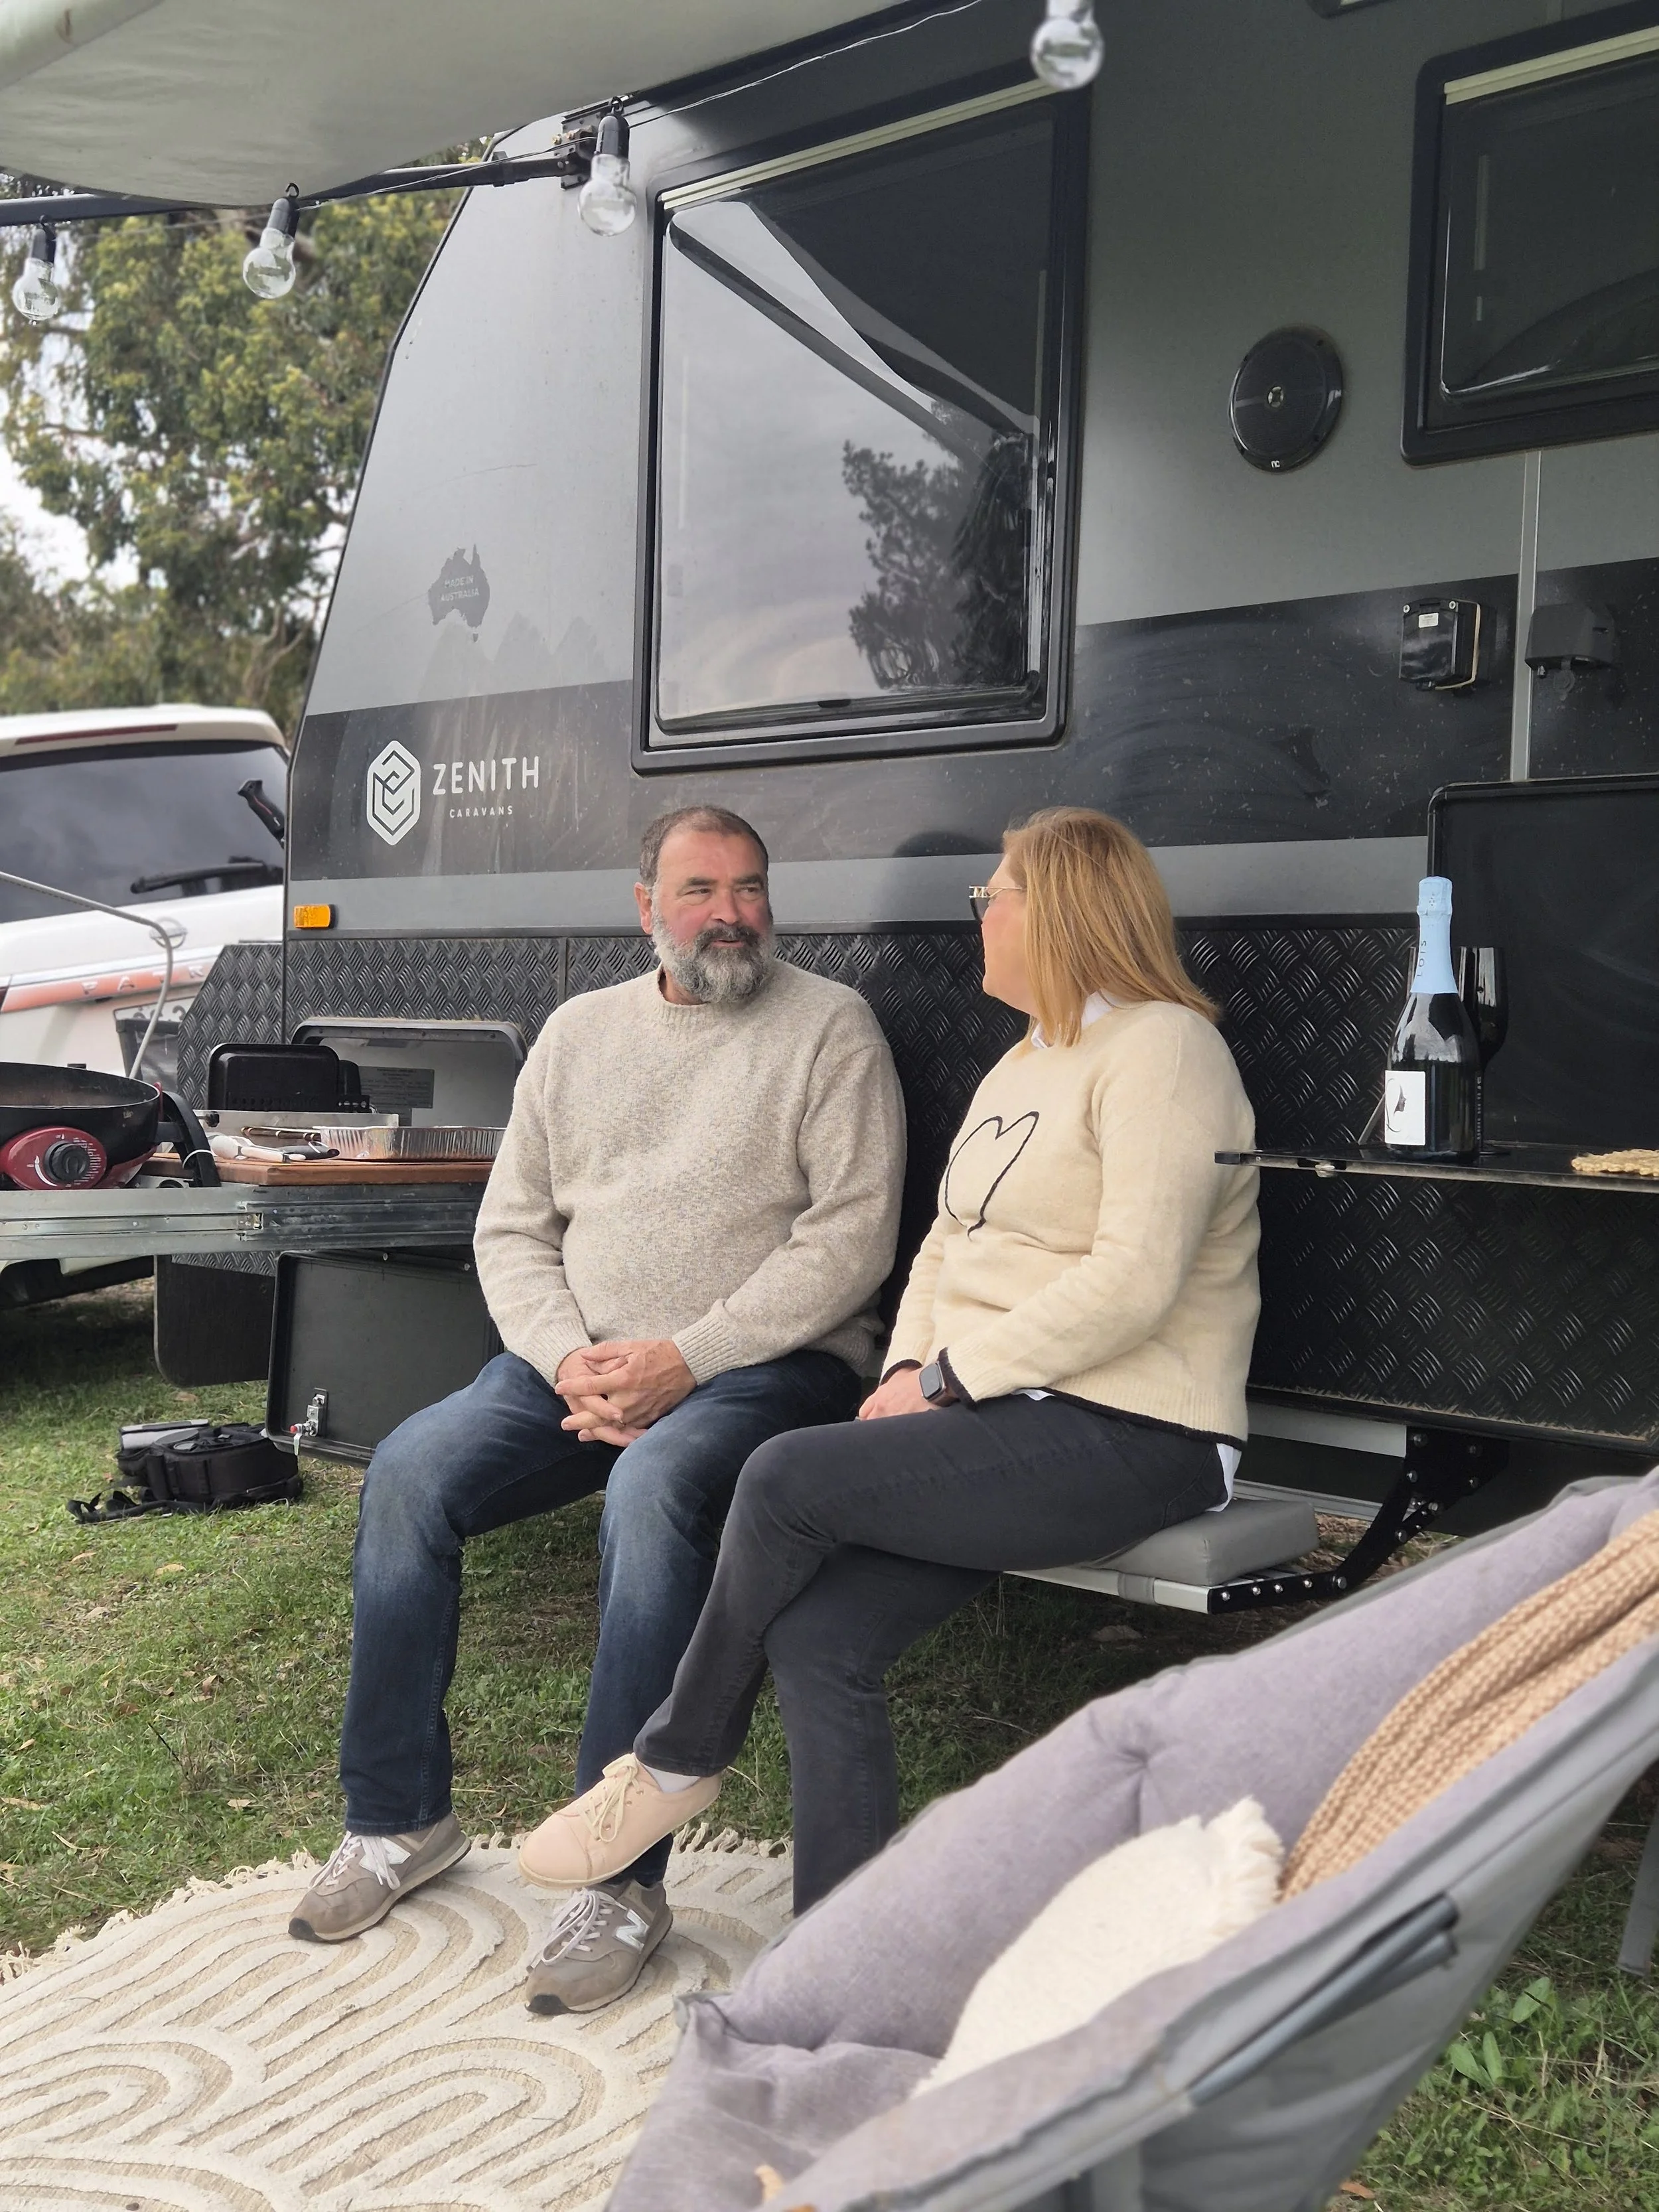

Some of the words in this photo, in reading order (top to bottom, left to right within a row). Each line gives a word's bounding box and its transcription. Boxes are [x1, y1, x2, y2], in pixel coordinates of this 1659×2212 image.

[441, 588, 480, 601] AUSTRALIA
[433, 756, 539, 795] ZENITH
[450, 806, 513, 818] CARAVANS
[1417, 940, 1427, 976] LOIS
